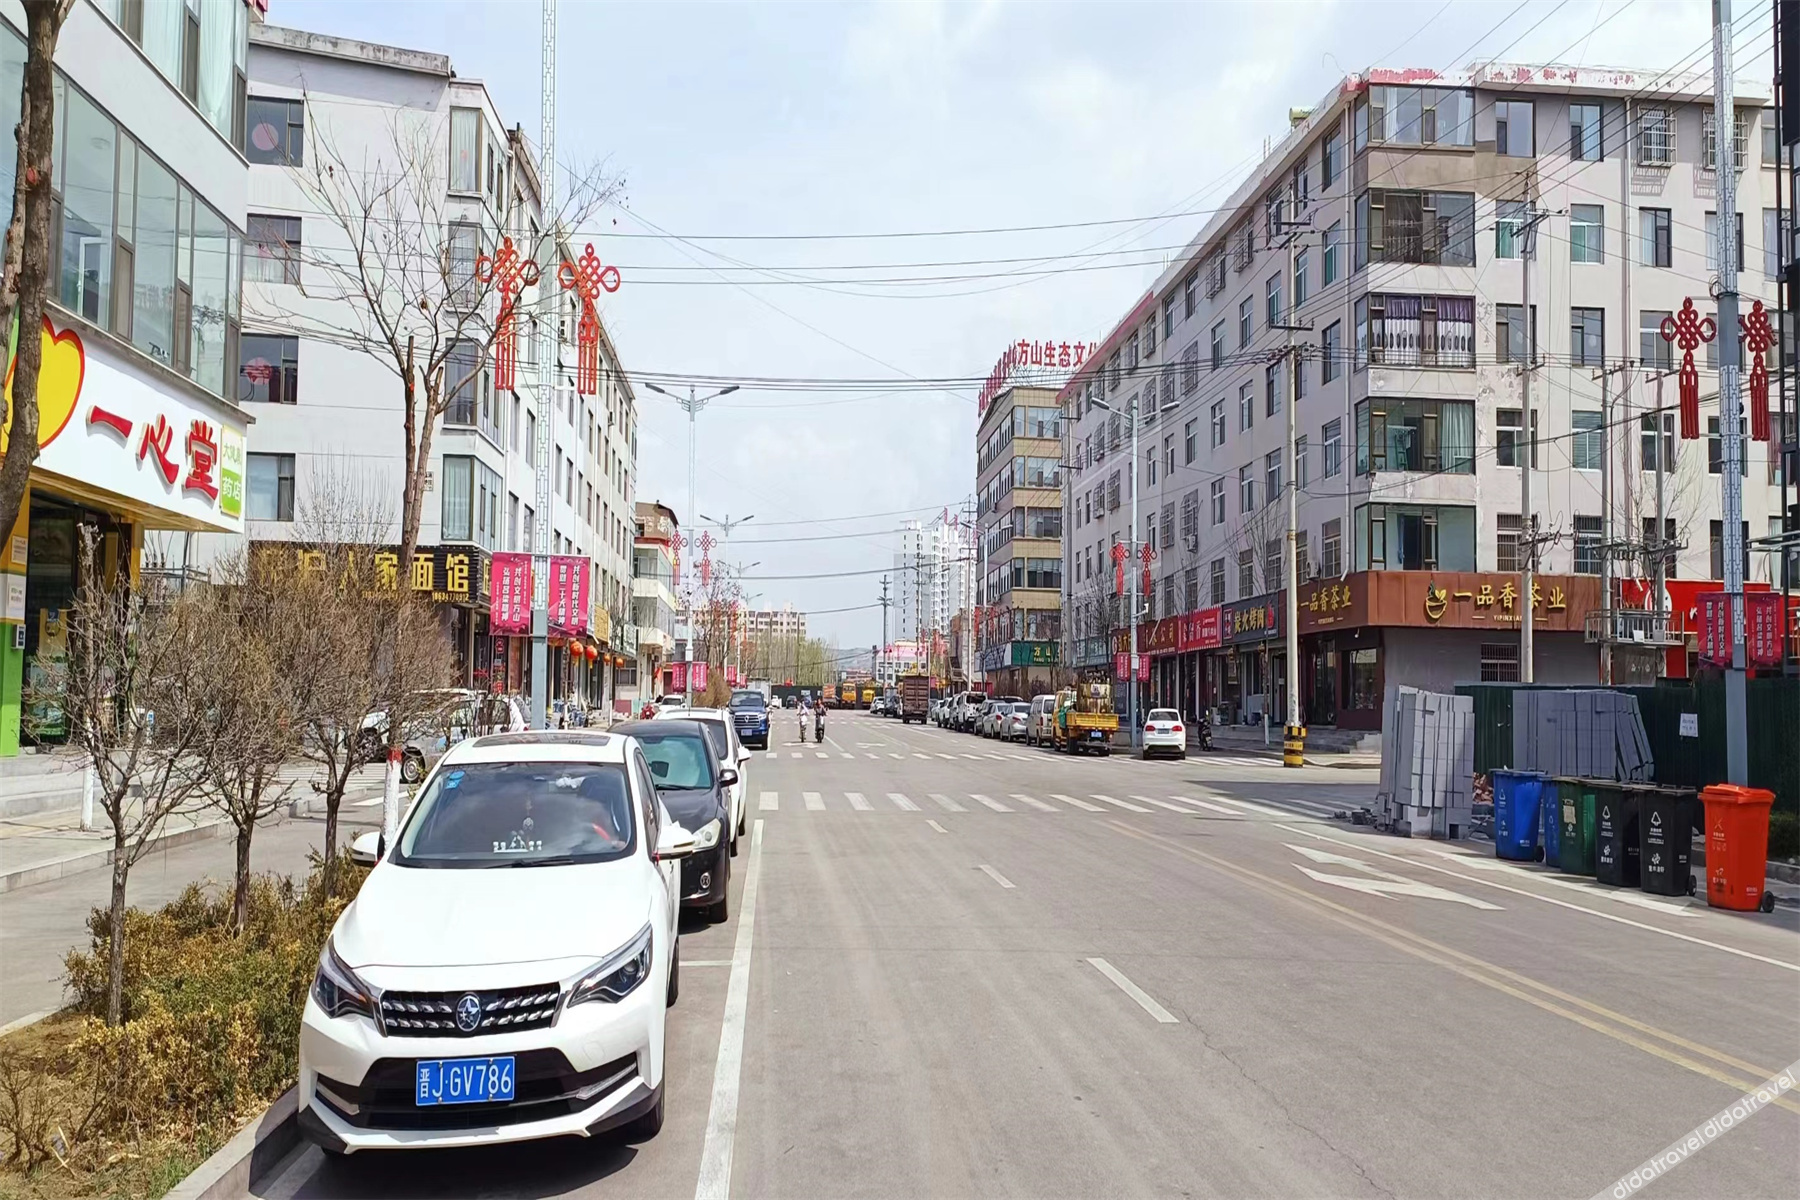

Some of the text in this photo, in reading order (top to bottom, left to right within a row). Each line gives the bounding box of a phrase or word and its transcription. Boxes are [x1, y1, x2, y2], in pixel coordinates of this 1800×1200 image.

[86, 404, 219, 501] 一心堂
[222, 476, 242, 501] 药店
[1300, 585, 1352, 612] 一品香茶业
[1234, 605, 1265, 634] 炭火烤肉
